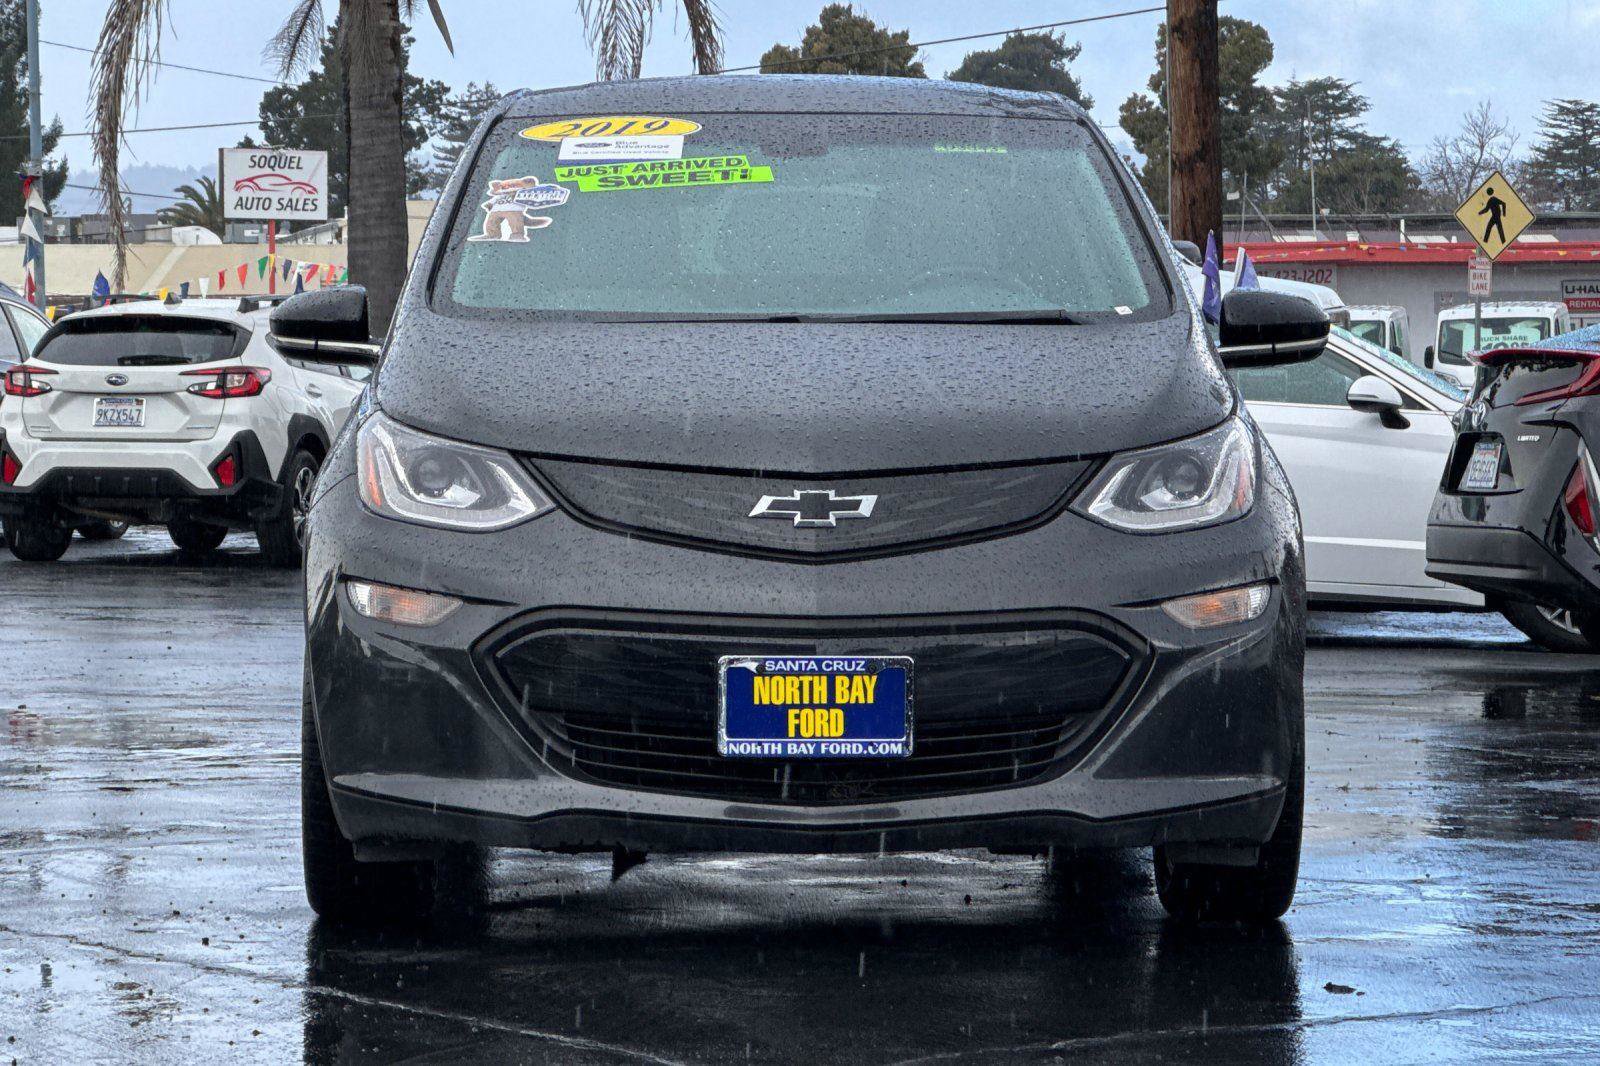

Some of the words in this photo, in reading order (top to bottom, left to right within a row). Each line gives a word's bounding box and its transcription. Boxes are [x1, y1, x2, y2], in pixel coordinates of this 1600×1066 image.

[551, 119, 671, 136] 2019
[248, 154, 304, 171] SOQUEL
[560, 164, 627, 178] JUST
[631, 157, 744, 174] ARRIVED
[597, 168, 750, 188] SWEET!
[234, 196, 273, 211] AUTO
[276, 197, 319, 212] SALES
[1472, 272, 1488, 281] BIKE
[1471, 282, 1489, 291] LANE
[764, 660, 819, 672] SANTA
[821, 660, 866, 672] CRUZ
[753, 675, 828, 705] NORTH
[835, 675, 878, 705] BAY
[787, 708, 845, 738] FORD
[728, 742, 782, 755] NORTH
[787, 742, 816, 755] BAY
[820, 741, 903, 755] FORD.COM
